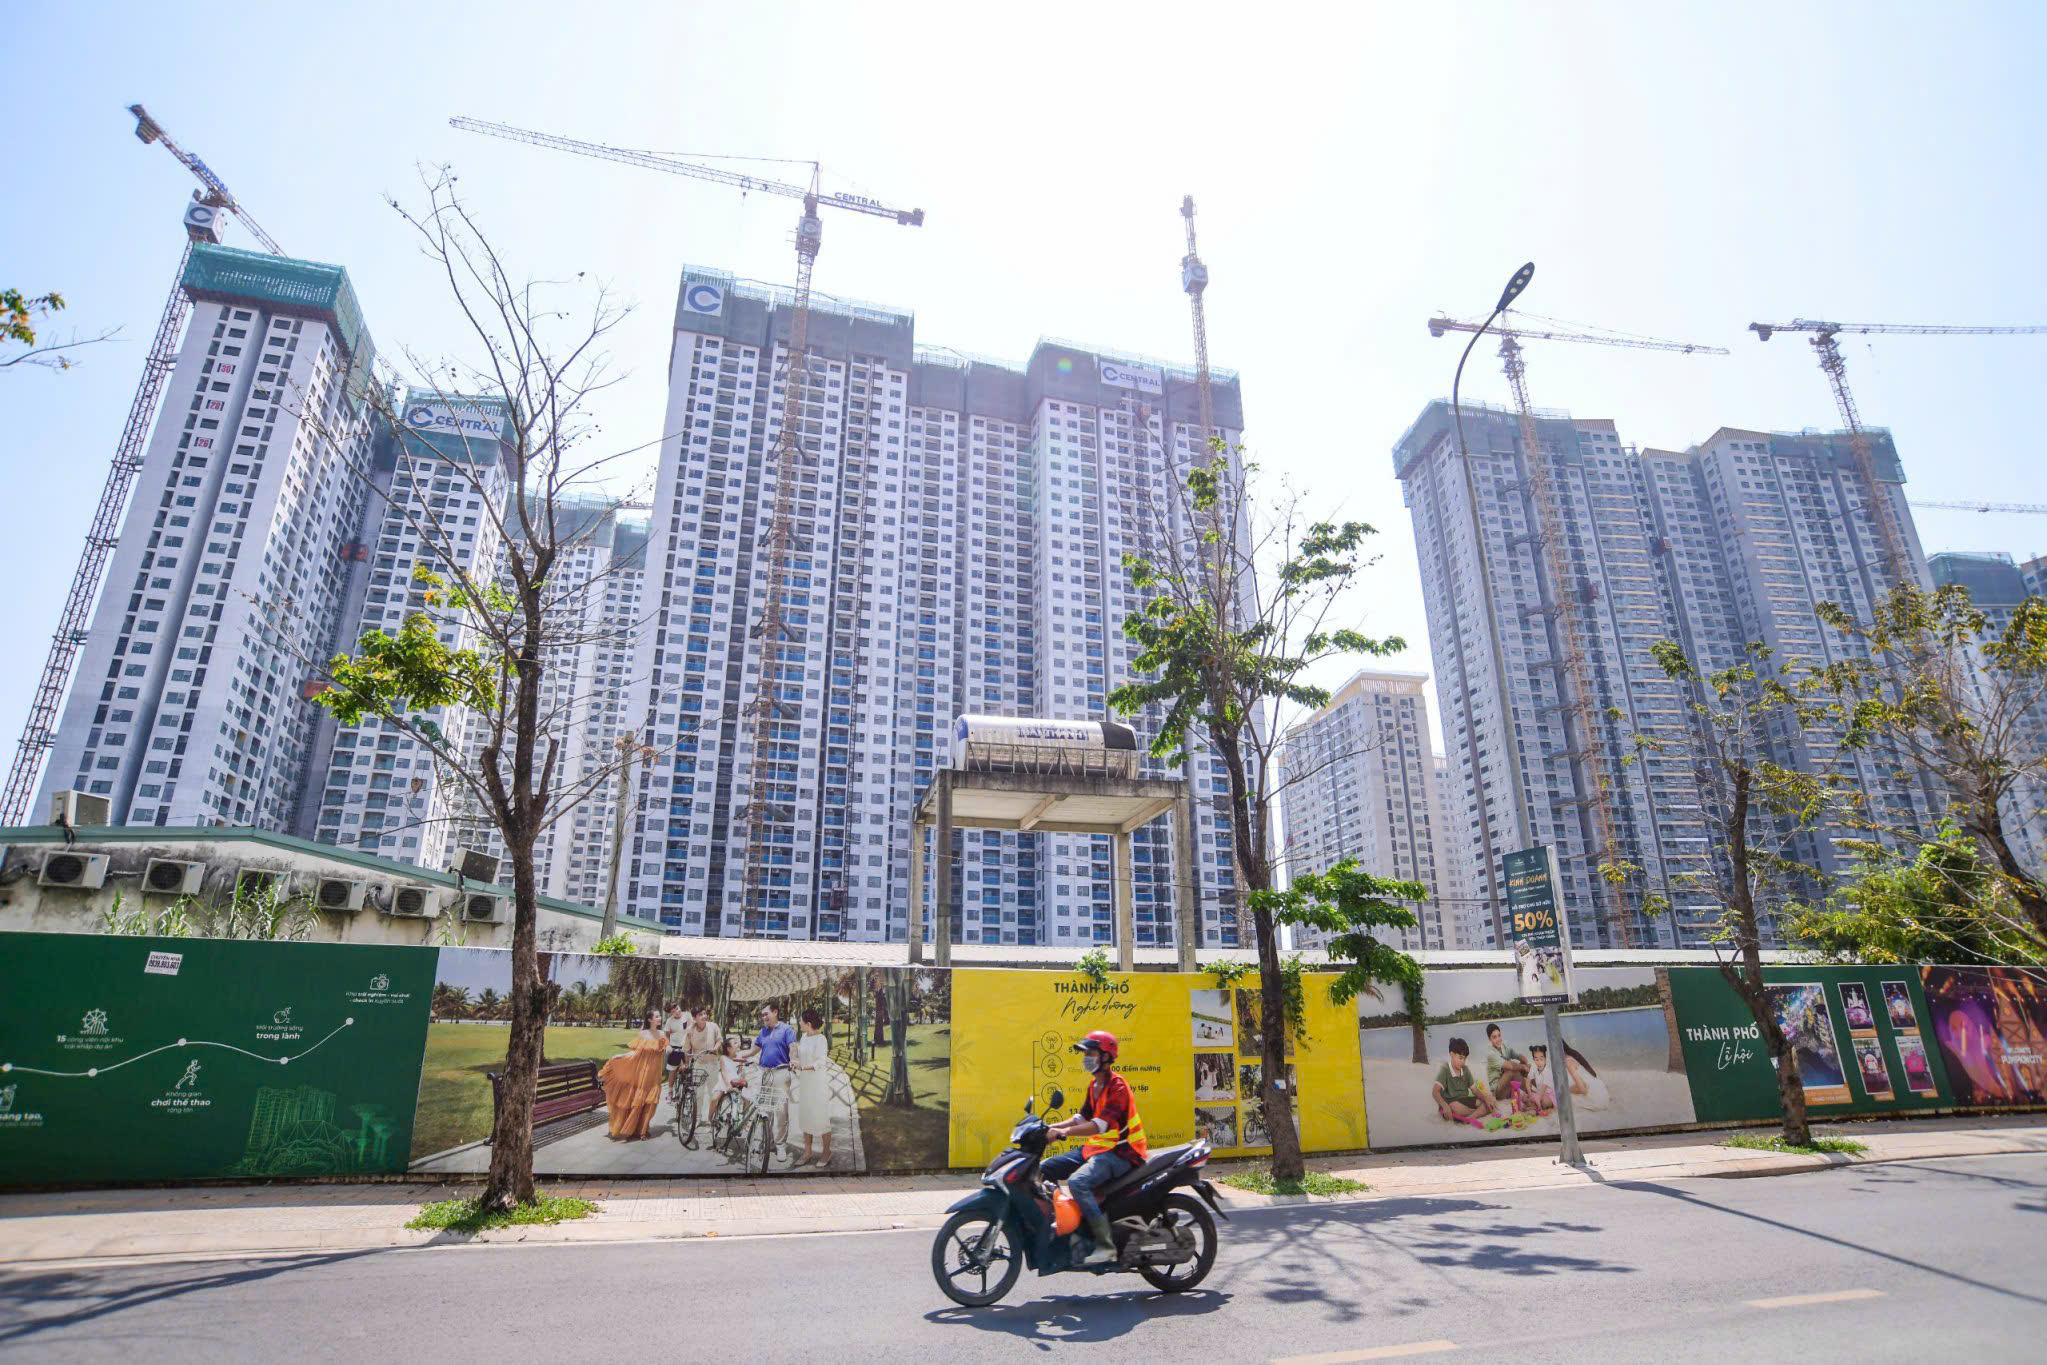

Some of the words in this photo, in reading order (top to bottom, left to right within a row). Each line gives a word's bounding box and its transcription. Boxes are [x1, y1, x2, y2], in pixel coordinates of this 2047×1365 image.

[834, 192, 882, 207] CENTRAL
[220, 364, 232, 374] 30
[1119, 373, 1161, 387] CENTRAL
[435, 415, 501, 433] CENTRAL
[1514, 909, 1553, 932] 50%
[1054, 980, 1098, 993] THÀNH
[1102, 978, 1130, 993] PHỐ
[256, 1032, 280, 1040] trong
[1686, 1024, 1730, 1041] THÀNH
[1733, 1021, 1760, 1040] PHỐ
[57, 1035, 67, 1043] 15
[1717, 1041, 1733, 1070] Lễ
[1733, 1040, 1754, 1064] hội
[1121, 1064, 1139, 1072] điểm
[1139, 1064, 1161, 1072] nướng
[172, 1098, 189, 1106] thể
